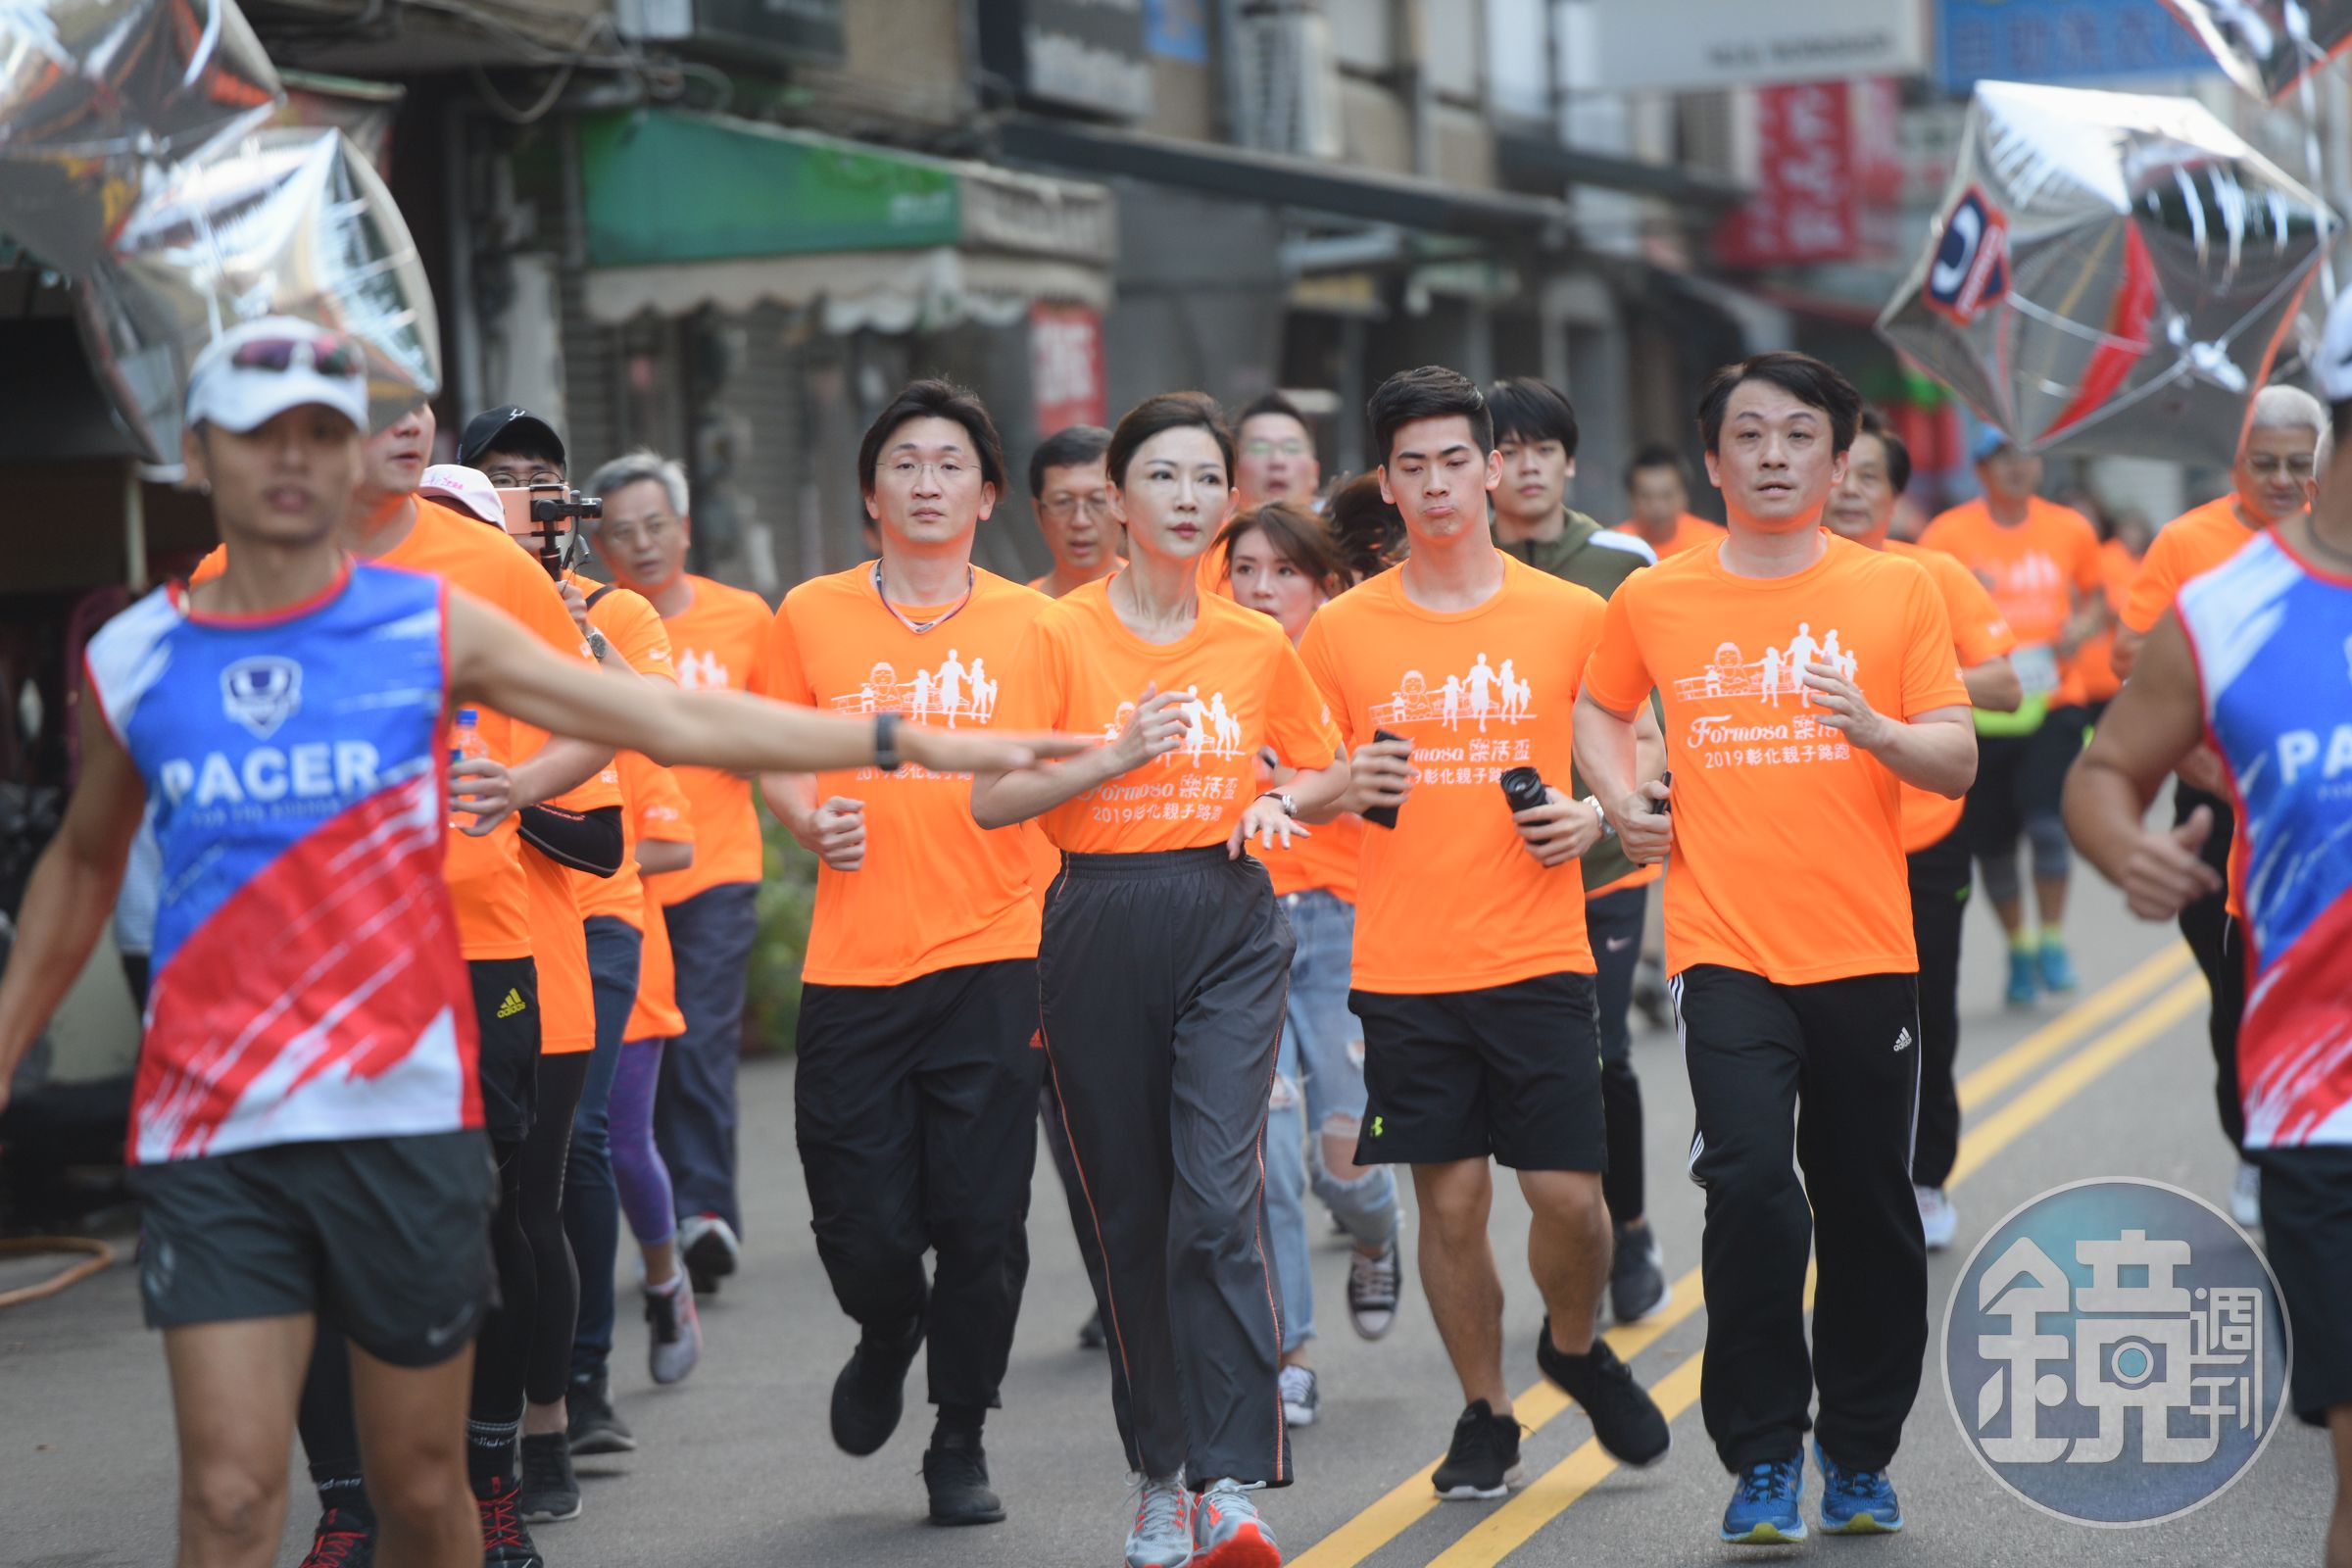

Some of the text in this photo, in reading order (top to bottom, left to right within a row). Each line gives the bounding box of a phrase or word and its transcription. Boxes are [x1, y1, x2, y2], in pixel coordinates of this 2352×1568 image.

[1688, 713, 1788, 748] Formosa
[1469, 738, 1530, 761] 樂活盃
[1704, 744, 1850, 768] 2019彰化親子路跑
[162, 740, 380, 807] PACER
[1179, 773, 1238, 800] 樂活盃
